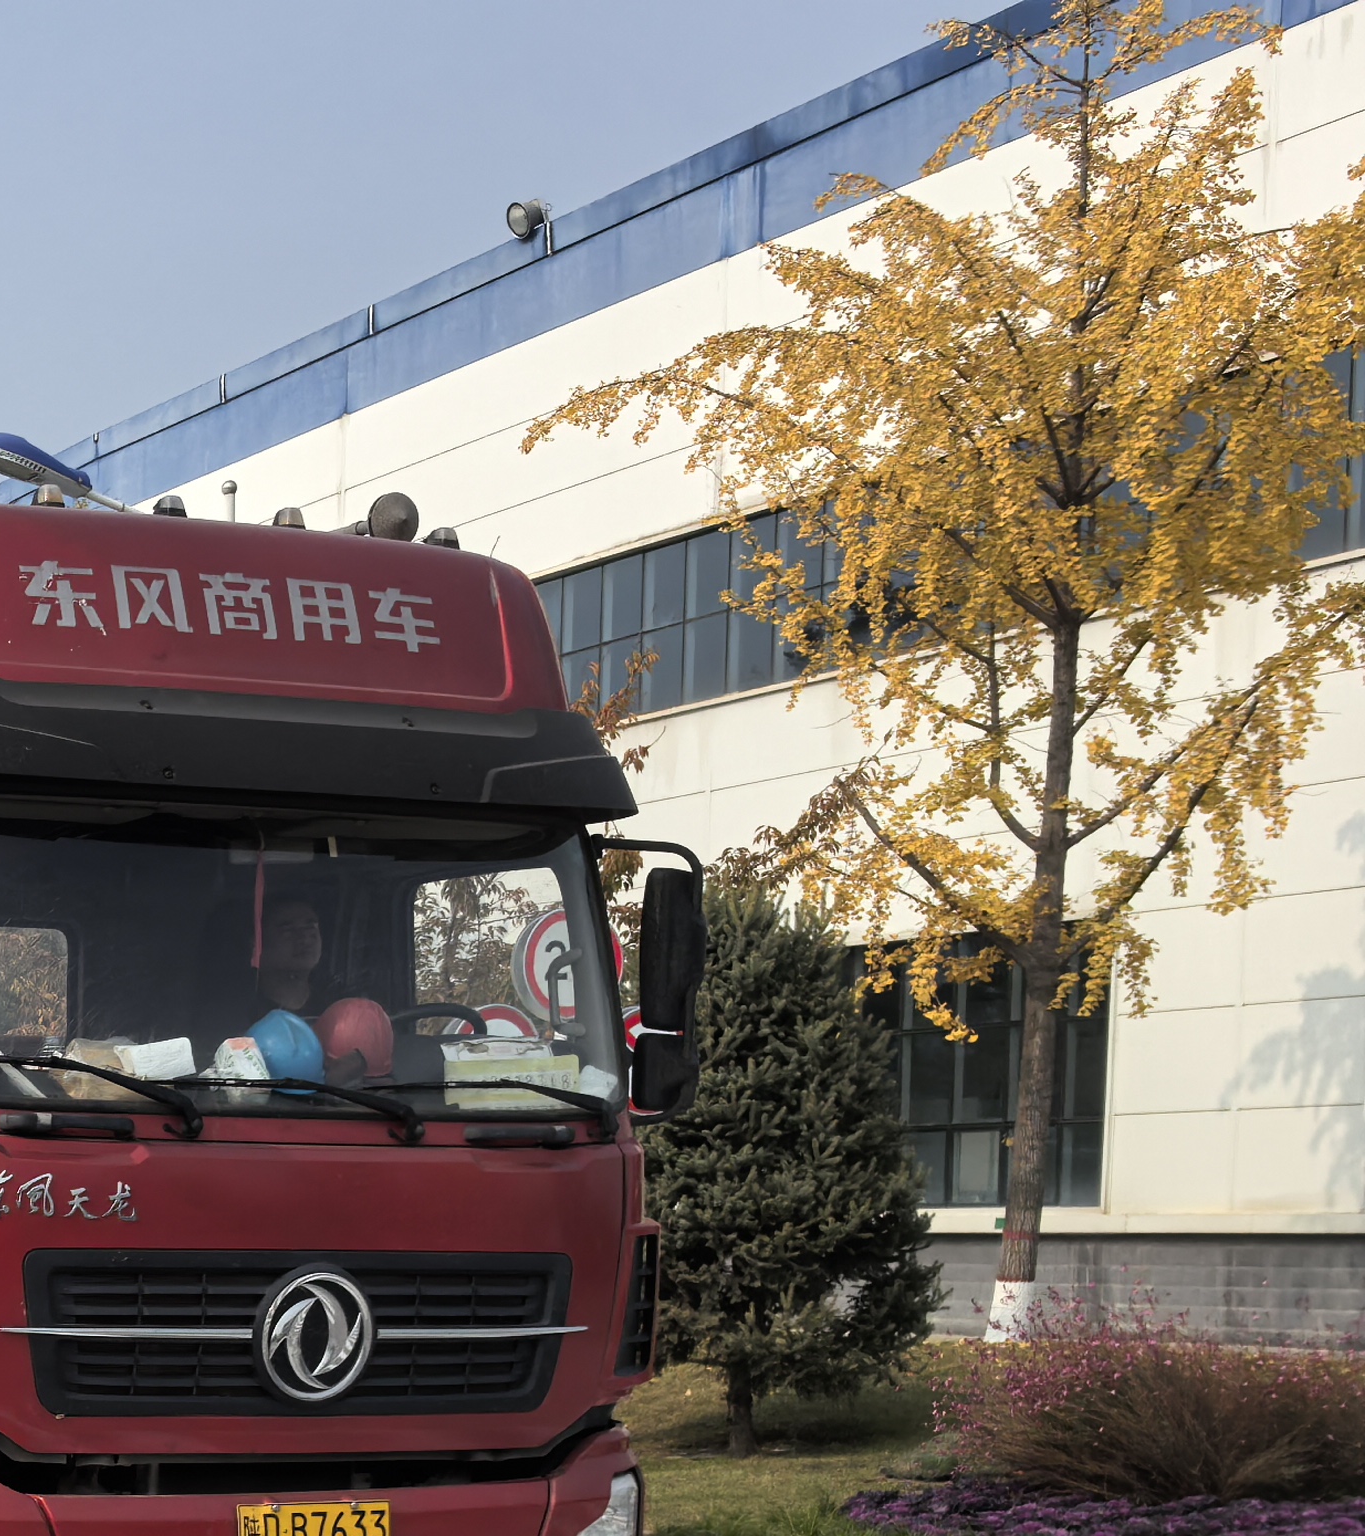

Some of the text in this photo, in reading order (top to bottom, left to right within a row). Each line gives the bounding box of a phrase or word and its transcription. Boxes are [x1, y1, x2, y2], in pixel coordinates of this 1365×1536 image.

[18, 560, 441, 653] 东风商用车
